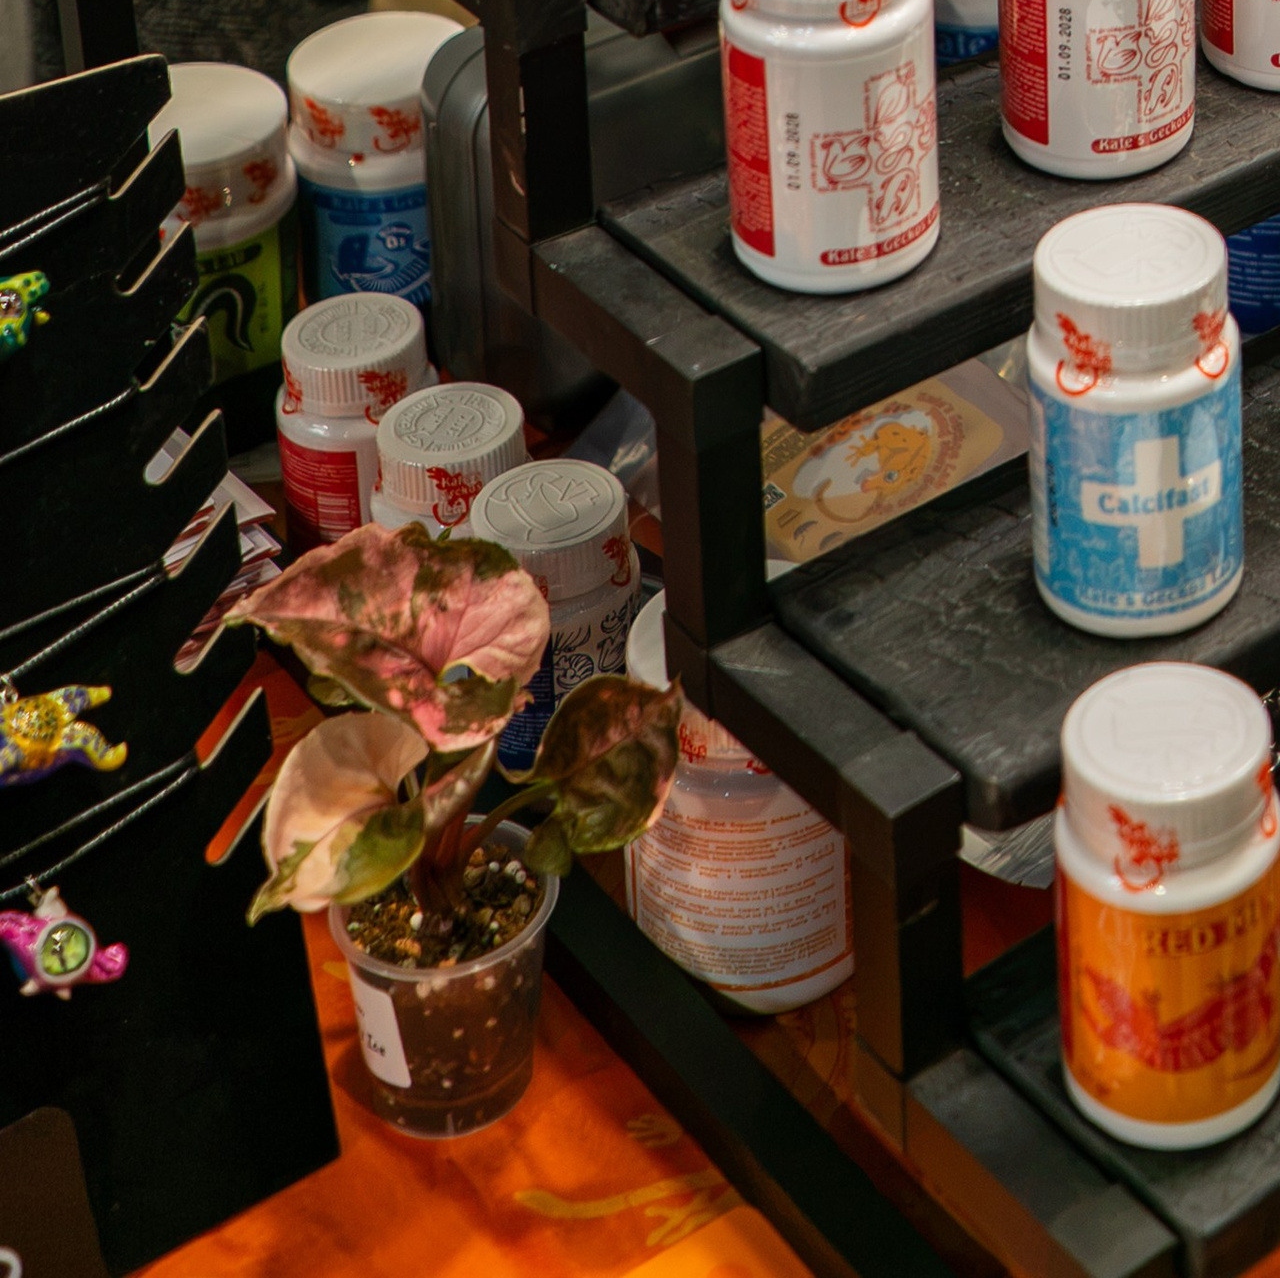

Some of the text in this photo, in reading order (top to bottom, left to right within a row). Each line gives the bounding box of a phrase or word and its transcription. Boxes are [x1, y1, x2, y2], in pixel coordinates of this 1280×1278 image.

[1058, 7, 1073, 81] 01.09.2028
[786, 112, 799, 191] 01.09.2028
[1099, 115, 1186, 153] Kate's Geckos
[826, 221, 926, 265] Kate's Geckos
[1097, 479, 1210, 516] Calcifast
